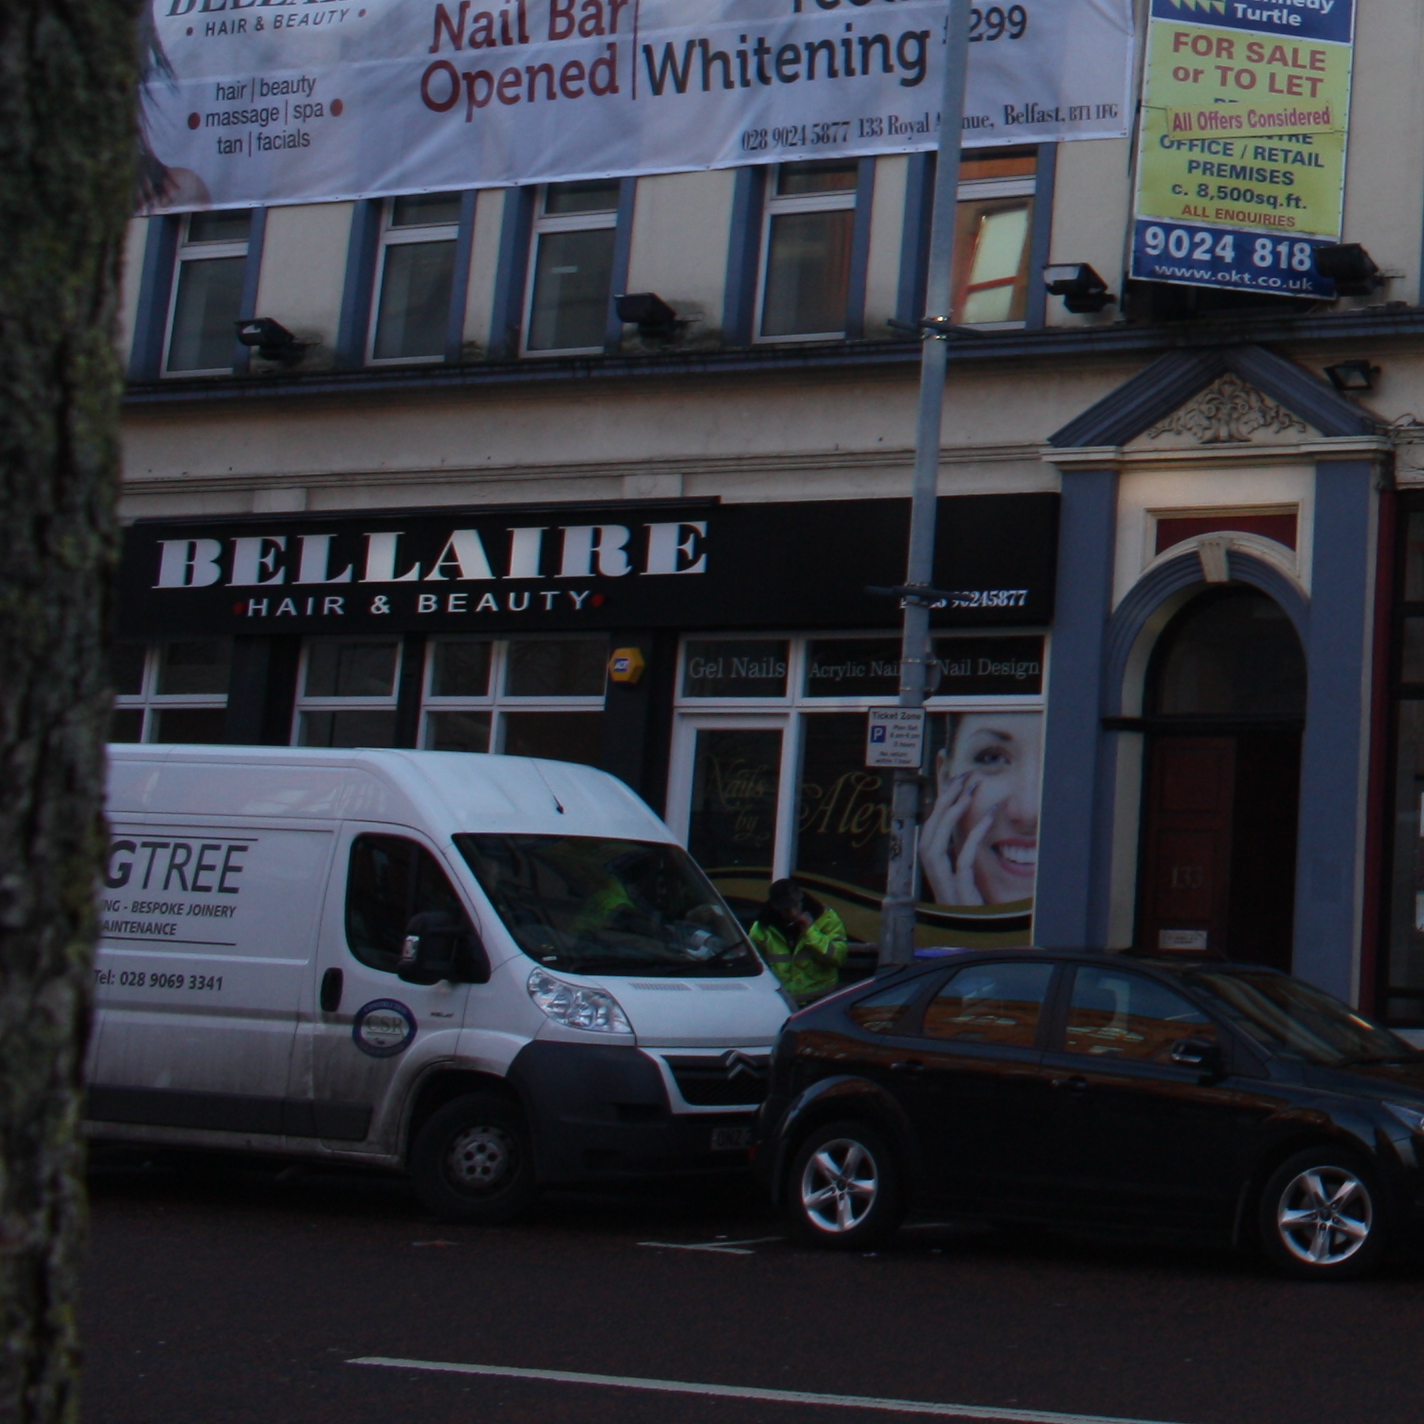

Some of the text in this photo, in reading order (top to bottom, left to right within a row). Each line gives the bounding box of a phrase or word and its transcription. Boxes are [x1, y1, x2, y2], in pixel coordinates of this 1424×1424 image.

[205, 7, 351, 37] HAIR & BEAUTY
[942, 4, 1027, 45] 299
[1233, 3, 1303, 27] Turtle
[642, 22, 931, 97] Whitening
[1172, 31, 1327, 72] FOR SALE
[216, 75, 317, 102] hair beauty
[420, 41, 620, 124] Opened
[1172, 65, 1325, 99] or TO LET
[205, 101, 324, 128] massage spa
[742, 128, 768, 151] 028
[773, 124, 808, 149] 9024
[811, 120, 851, 146] 5877
[857, 116, 884, 138] 133
[887, 112, 931, 140] Royal
[935, 112, 995, 132] nue,
[1003, 102, 1066, 126] Belfast,
[1069, 105, 1091, 121] BT1
[1172, 105, 1331, 132] All Offers Considered
[217, 128, 311, 155] tan facials
[1159, 133, 1234, 157] OFFICE
[1253, 145, 1325, 168] RETAIL
[1187, 159, 1295, 186] PREMISES
[1181, 204, 1296, 228] ALL ENQUIRIES
[1144, 225, 1313, 272] 9024 818
[1154, 264, 1313, 291] www.okt.co.uk
[151, 520, 708, 590] BELLAIRE
[246, 589, 593, 618] HAIR & BEAUTY
[689, 657, 787, 679] Gel Nails
[808, 660, 900, 682] Acrylic Nai
[936, 658, 1040, 679] Nail Design
[873, 727, 883, 741] P
[102, 840, 249, 894] GTREE
[1171, 865, 1203, 889] 133
[131, 900, 184, 916] BESPOKE
[186, 903, 237, 918] JOINERY
[102, 920, 178, 936] AINTENANCE
[94, 969, 224, 991] Tel: 028 9069 3341
